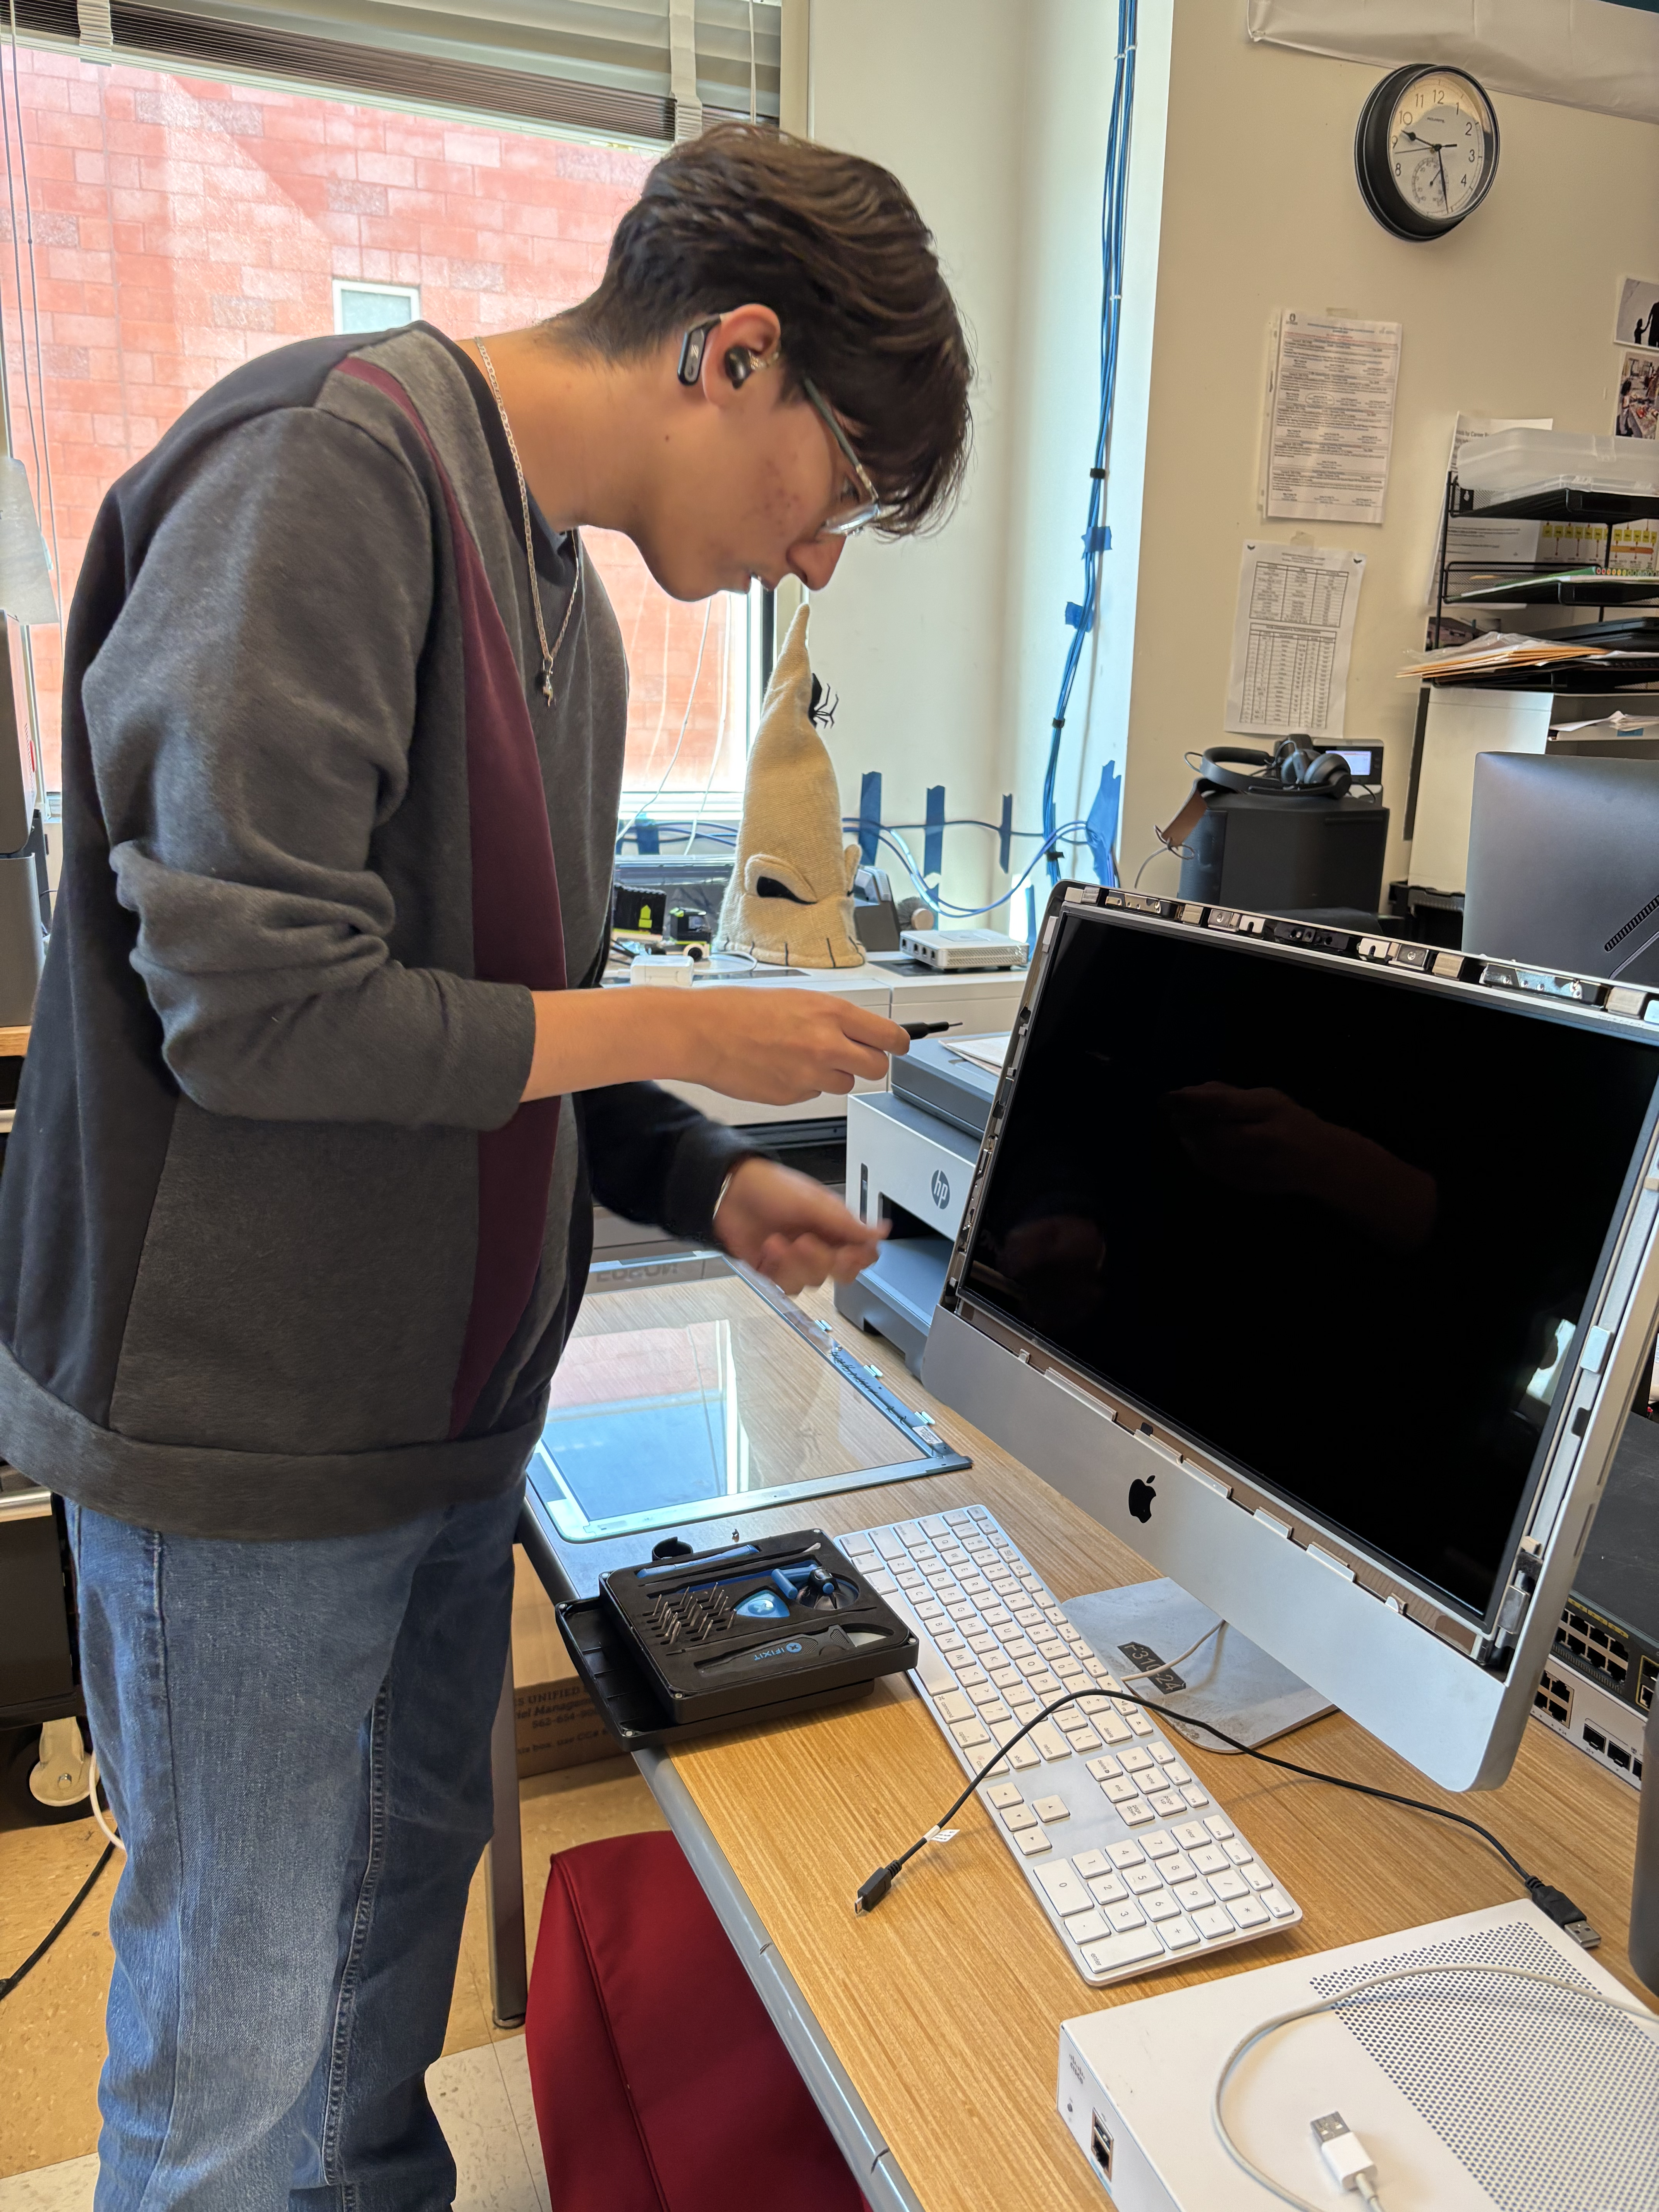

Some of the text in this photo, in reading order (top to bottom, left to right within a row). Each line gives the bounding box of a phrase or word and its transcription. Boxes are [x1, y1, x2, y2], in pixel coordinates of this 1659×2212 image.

[1415, 93, 1424, 108] 11
[1433, 89, 1445, 105] 12
[1456, 102, 1459, 116] 1
[1398, 110, 1413, 126] 10
[1465, 122, 1472, 136] 2
[1392, 135, 1398, 149] 9
[1468, 149, 1475, 163] 3
[1395, 162, 1401, 177] 8
[1460, 173, 1467, 187] 4
[933, 1170, 949, 1209] hp
[754, 1647, 785, 1661] IFIXIT
[528, 1686, 581, 1704] UNIFIED
[941, 1702, 955, 1718] command
[958, 1731, 970, 1743] option
[1104, 1727, 1114, 1738] delete
[1043, 1744, 1053, 1755] return
[1014, 1755, 1023, 1763] shift
[1097, 1759, 1107, 1770] delete
[1146, 1774, 1155, 1784] home
[1162, 1795, 1174, 1805] page
[1127, 1805, 1136, 1816] down
[1132, 1804, 1142, 1815] page
[1186, 1829, 1195, 1838] clear
[1091, 1953, 1102, 1966] enter
